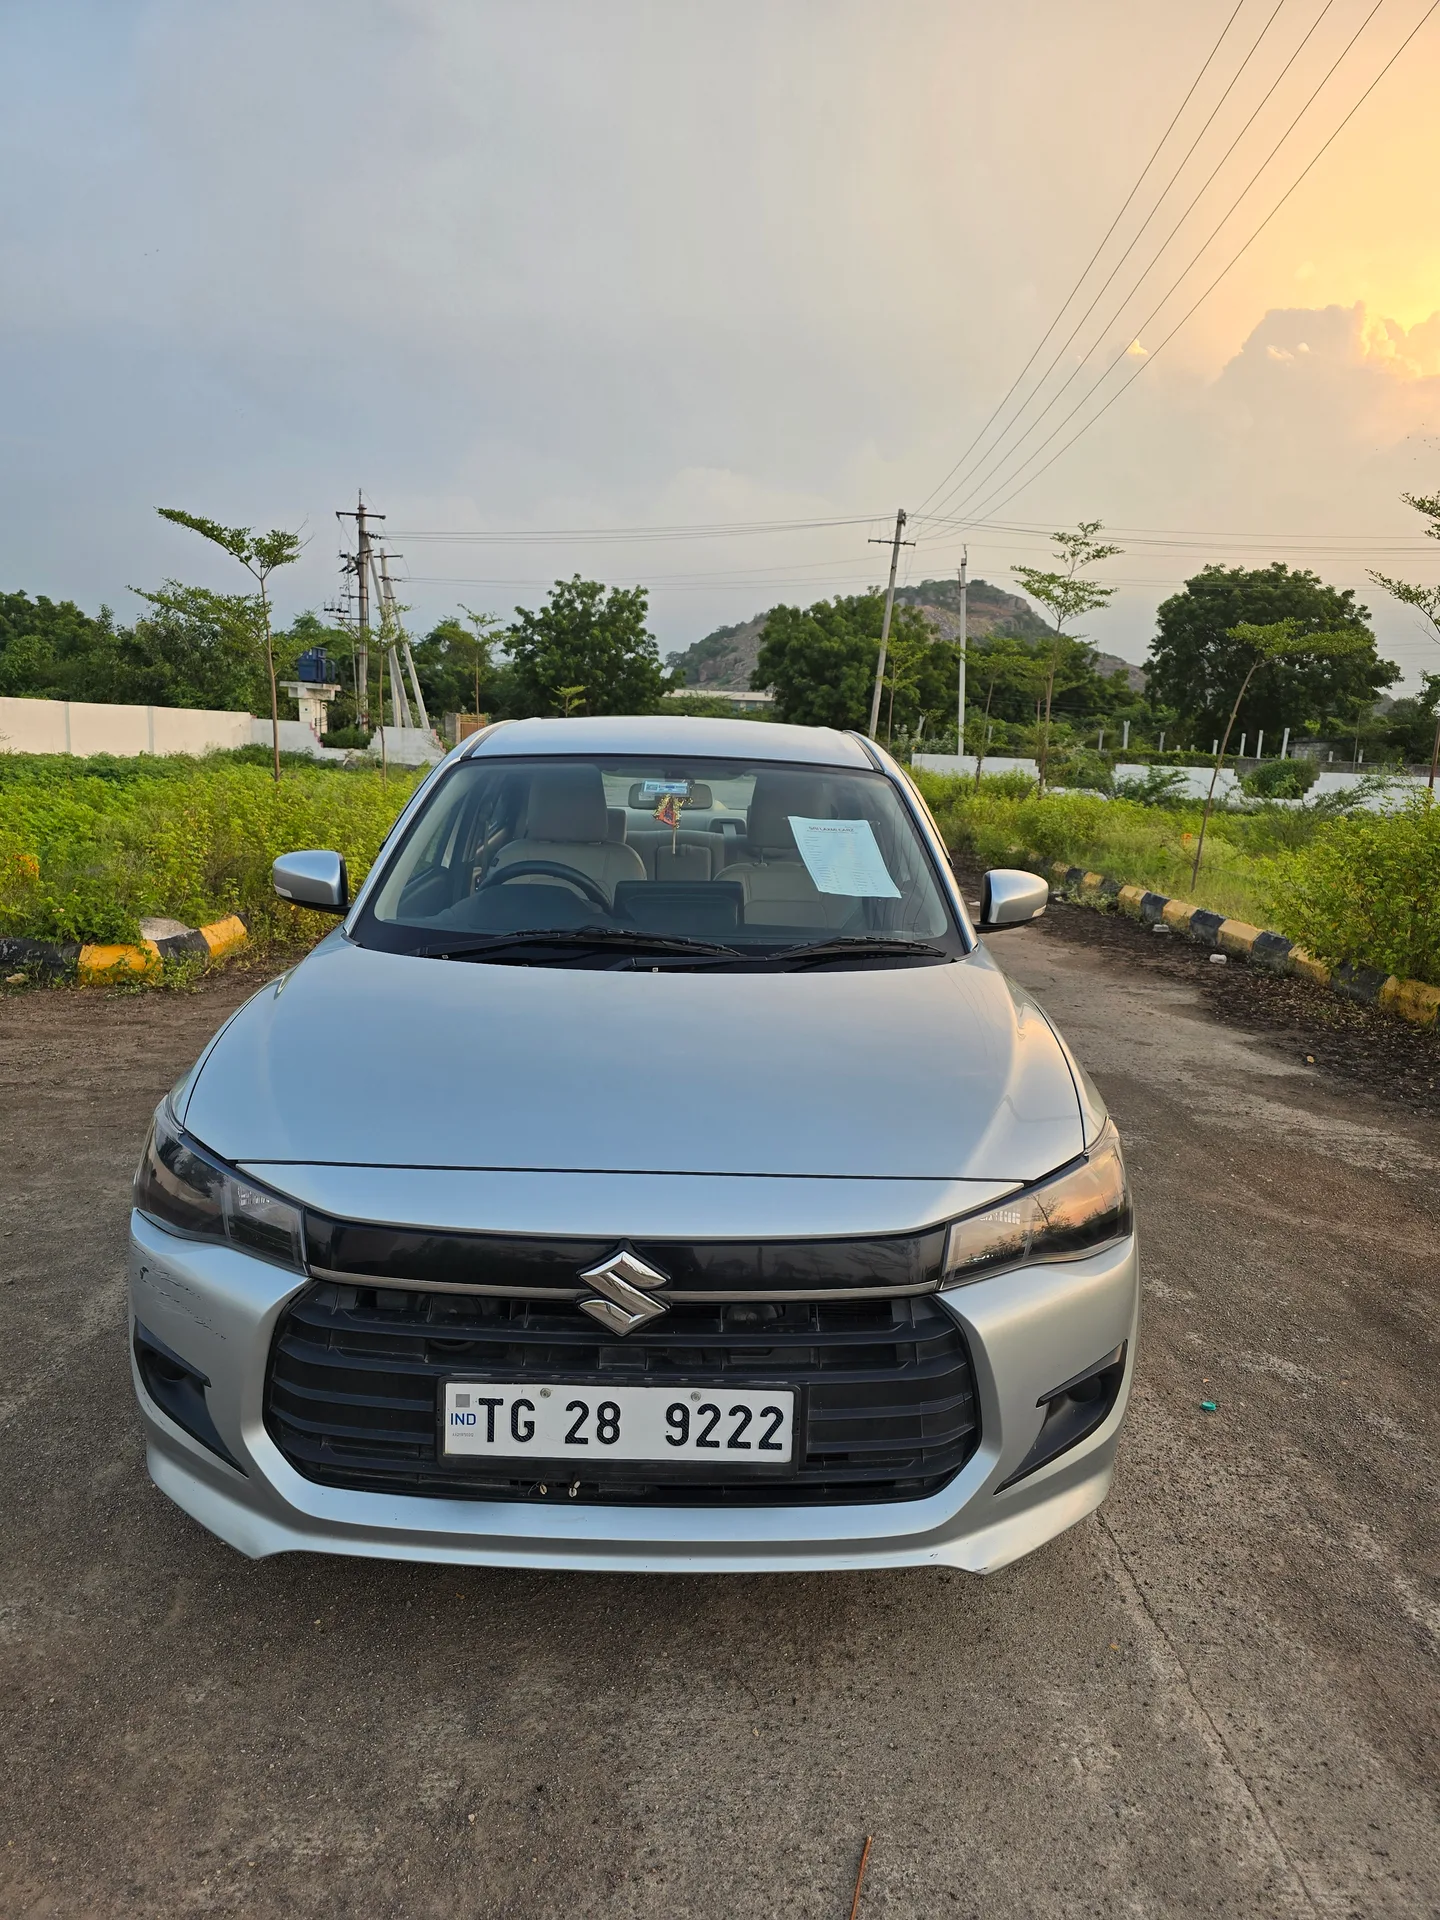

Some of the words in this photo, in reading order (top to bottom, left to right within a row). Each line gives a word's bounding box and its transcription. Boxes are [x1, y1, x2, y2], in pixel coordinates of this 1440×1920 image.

[450, 1413, 476, 1426] IND
[478, 1398, 535, 1443] TG
[564, 1400, 621, 1445] 28
[665, 1403, 784, 1450] 9222
